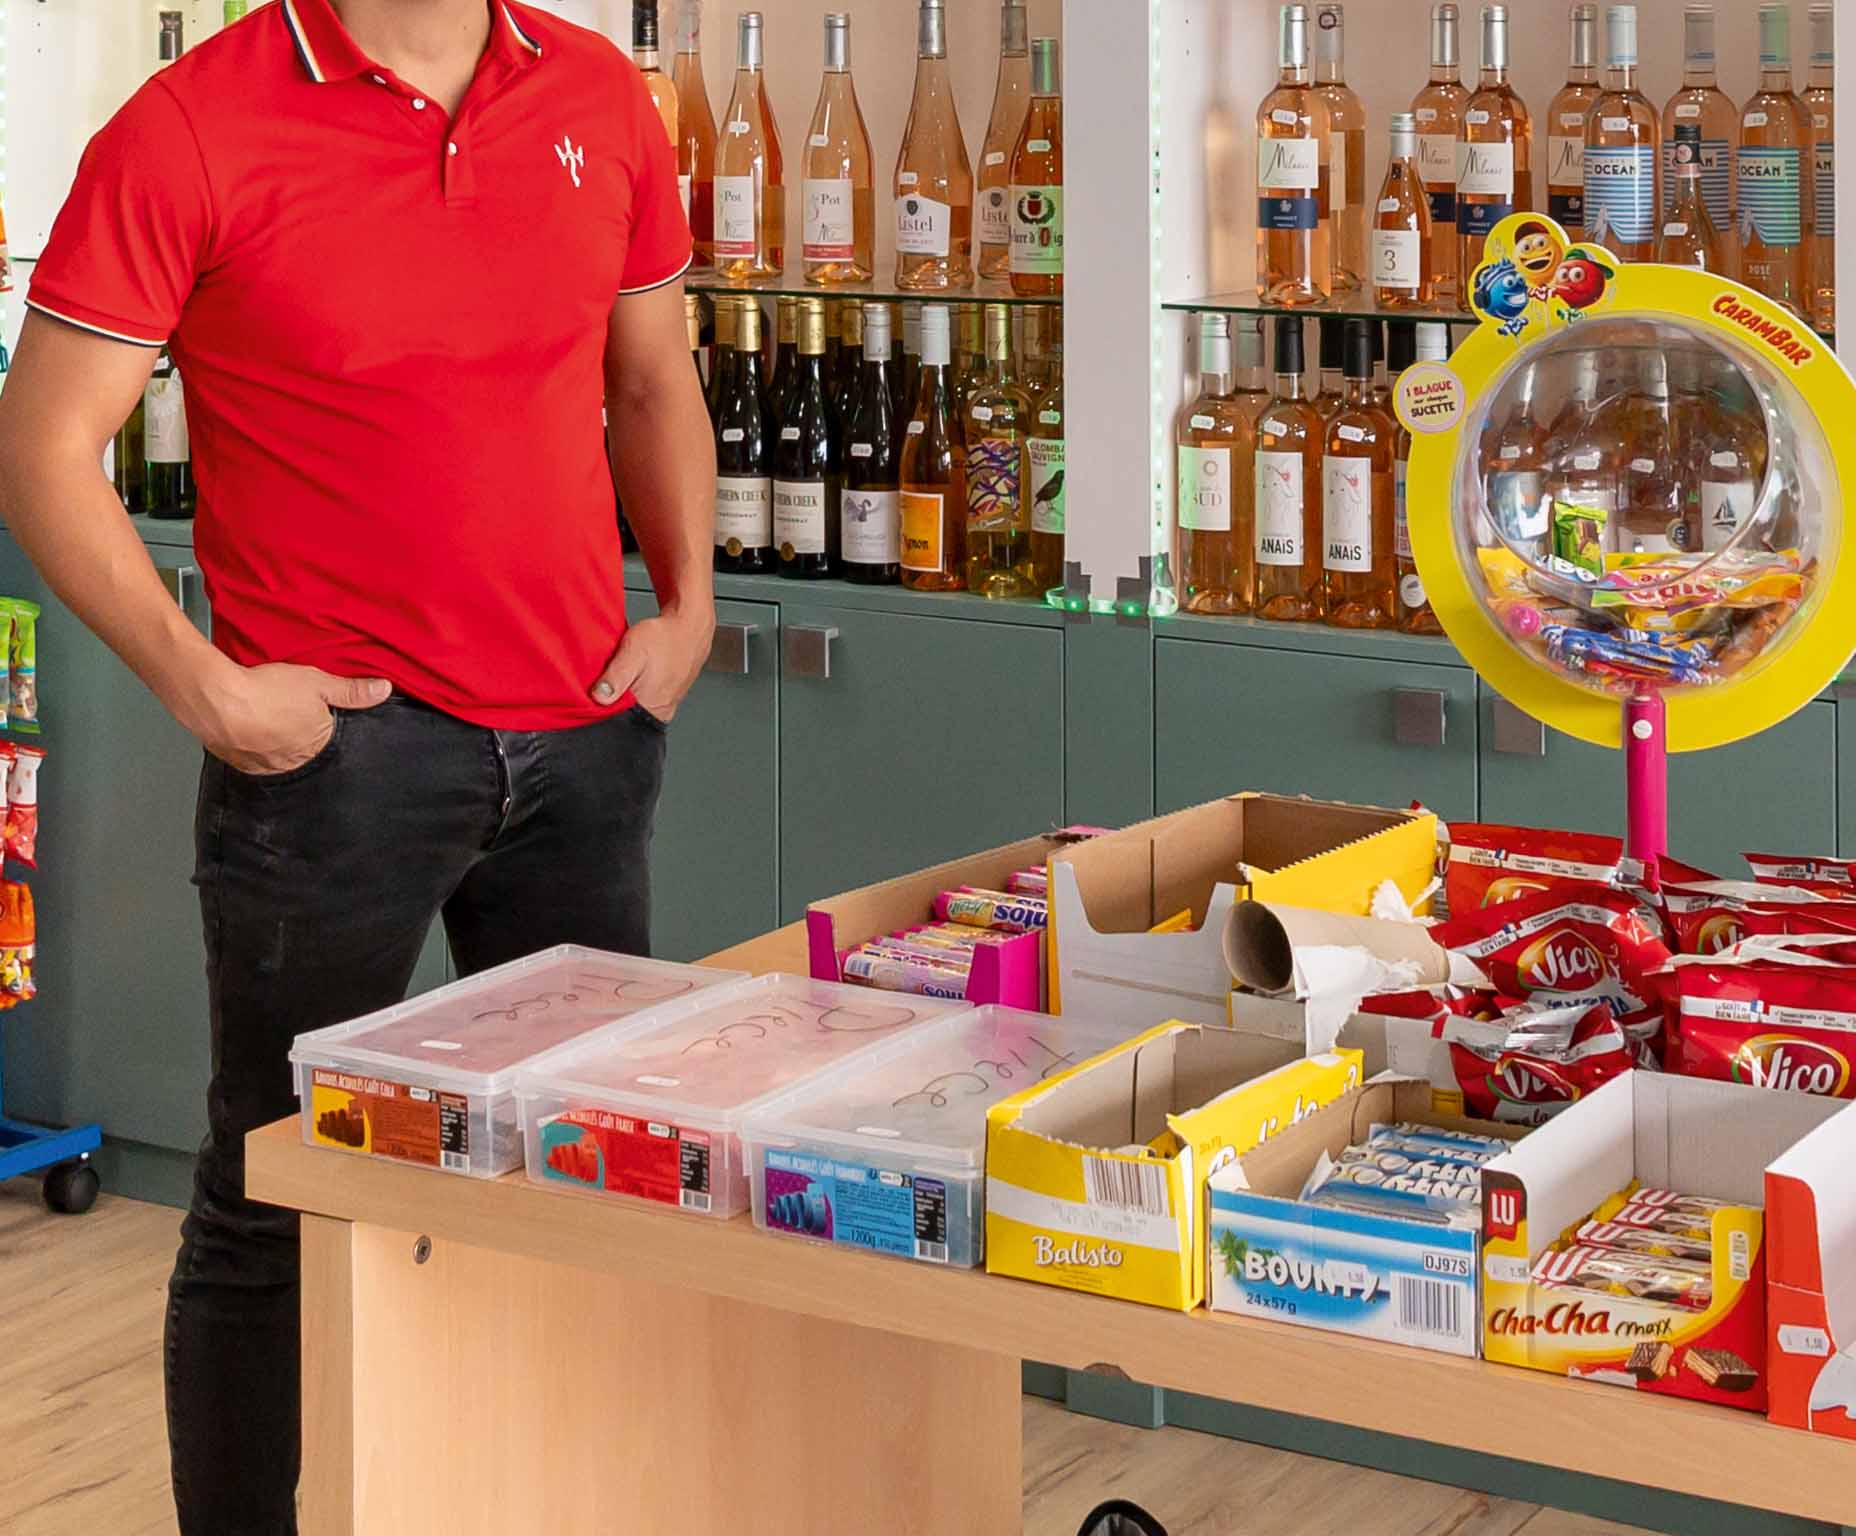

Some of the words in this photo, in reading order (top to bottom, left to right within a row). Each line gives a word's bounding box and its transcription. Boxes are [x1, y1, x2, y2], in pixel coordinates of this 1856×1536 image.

[1593, 163, 1637, 177] OCEAN
[1740, 164, 1783, 178] OCEAN
[723, 190, 742, 203] Pot
[821, 193, 841, 206] Pot
[897, 214, 934, 233] Listel
[1382, 249, 1397, 272] 3
[1414, 380, 1453, 396] BLAGUE
[1411, 401, 1456, 418] SUCETTE
[1530, 942, 1600, 985] Vico
[1754, 1046, 1837, 1092] Vico
[1490, 1194, 1516, 1226] LU
[1033, 1235, 1123, 1268] Balisto
[1424, 1255, 1469, 1275] DJ97S
[1533, 1247, 1582, 1283] LU
[1245, 1293, 1298, 1316] 24x57g
[1488, 1301, 1610, 1338] Cha-Cha
